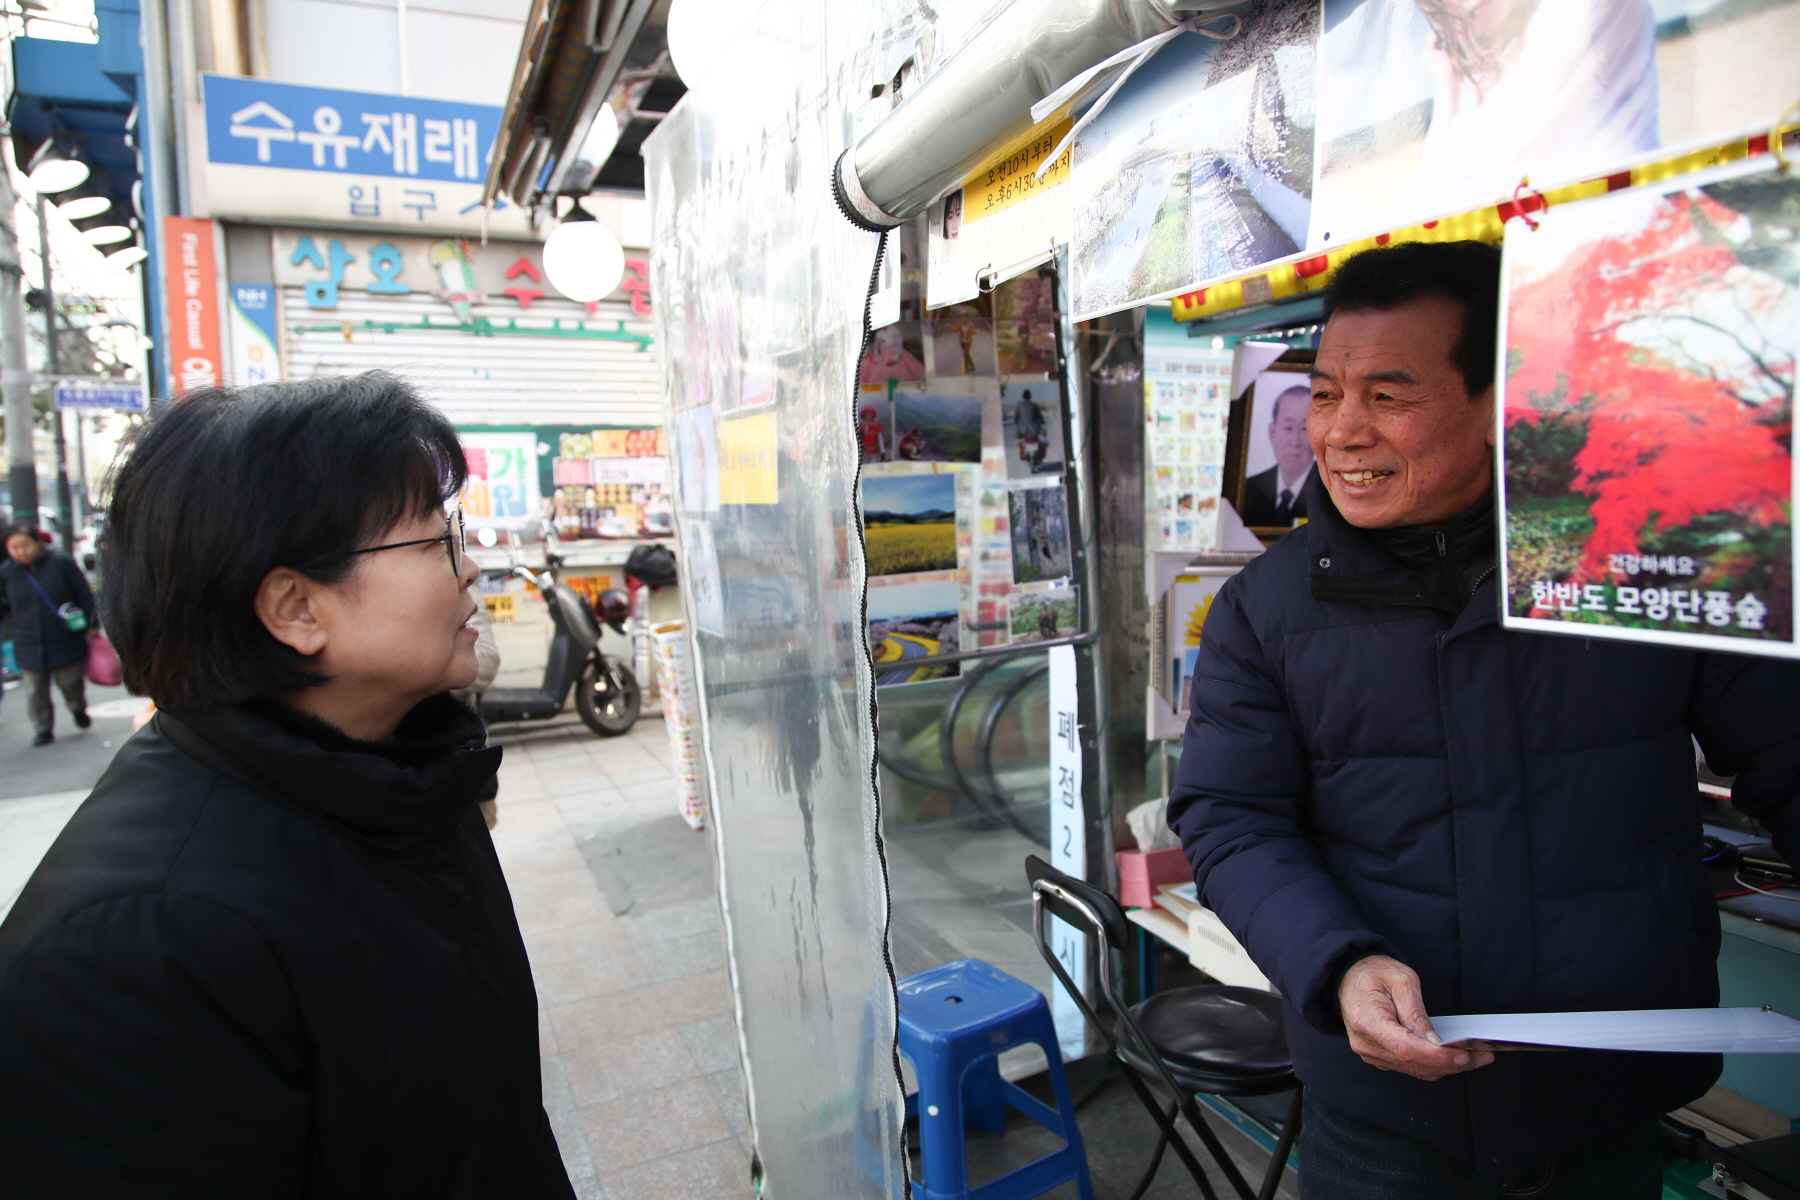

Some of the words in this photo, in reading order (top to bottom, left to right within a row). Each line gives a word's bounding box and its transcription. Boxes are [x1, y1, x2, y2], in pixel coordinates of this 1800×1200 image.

[229, 100, 498, 181] 수유재래
[349, 185, 437, 222] 입구
[183, 268, 201, 297] Life
[290, 234, 412, 309] 삼호
[185, 298, 205, 350] Casual
[1607, 553, 1696, 576] 건강하세요
[1531, 581, 1608, 612] 한반도
[1614, 586, 1768, 630] 모양단풍숲
